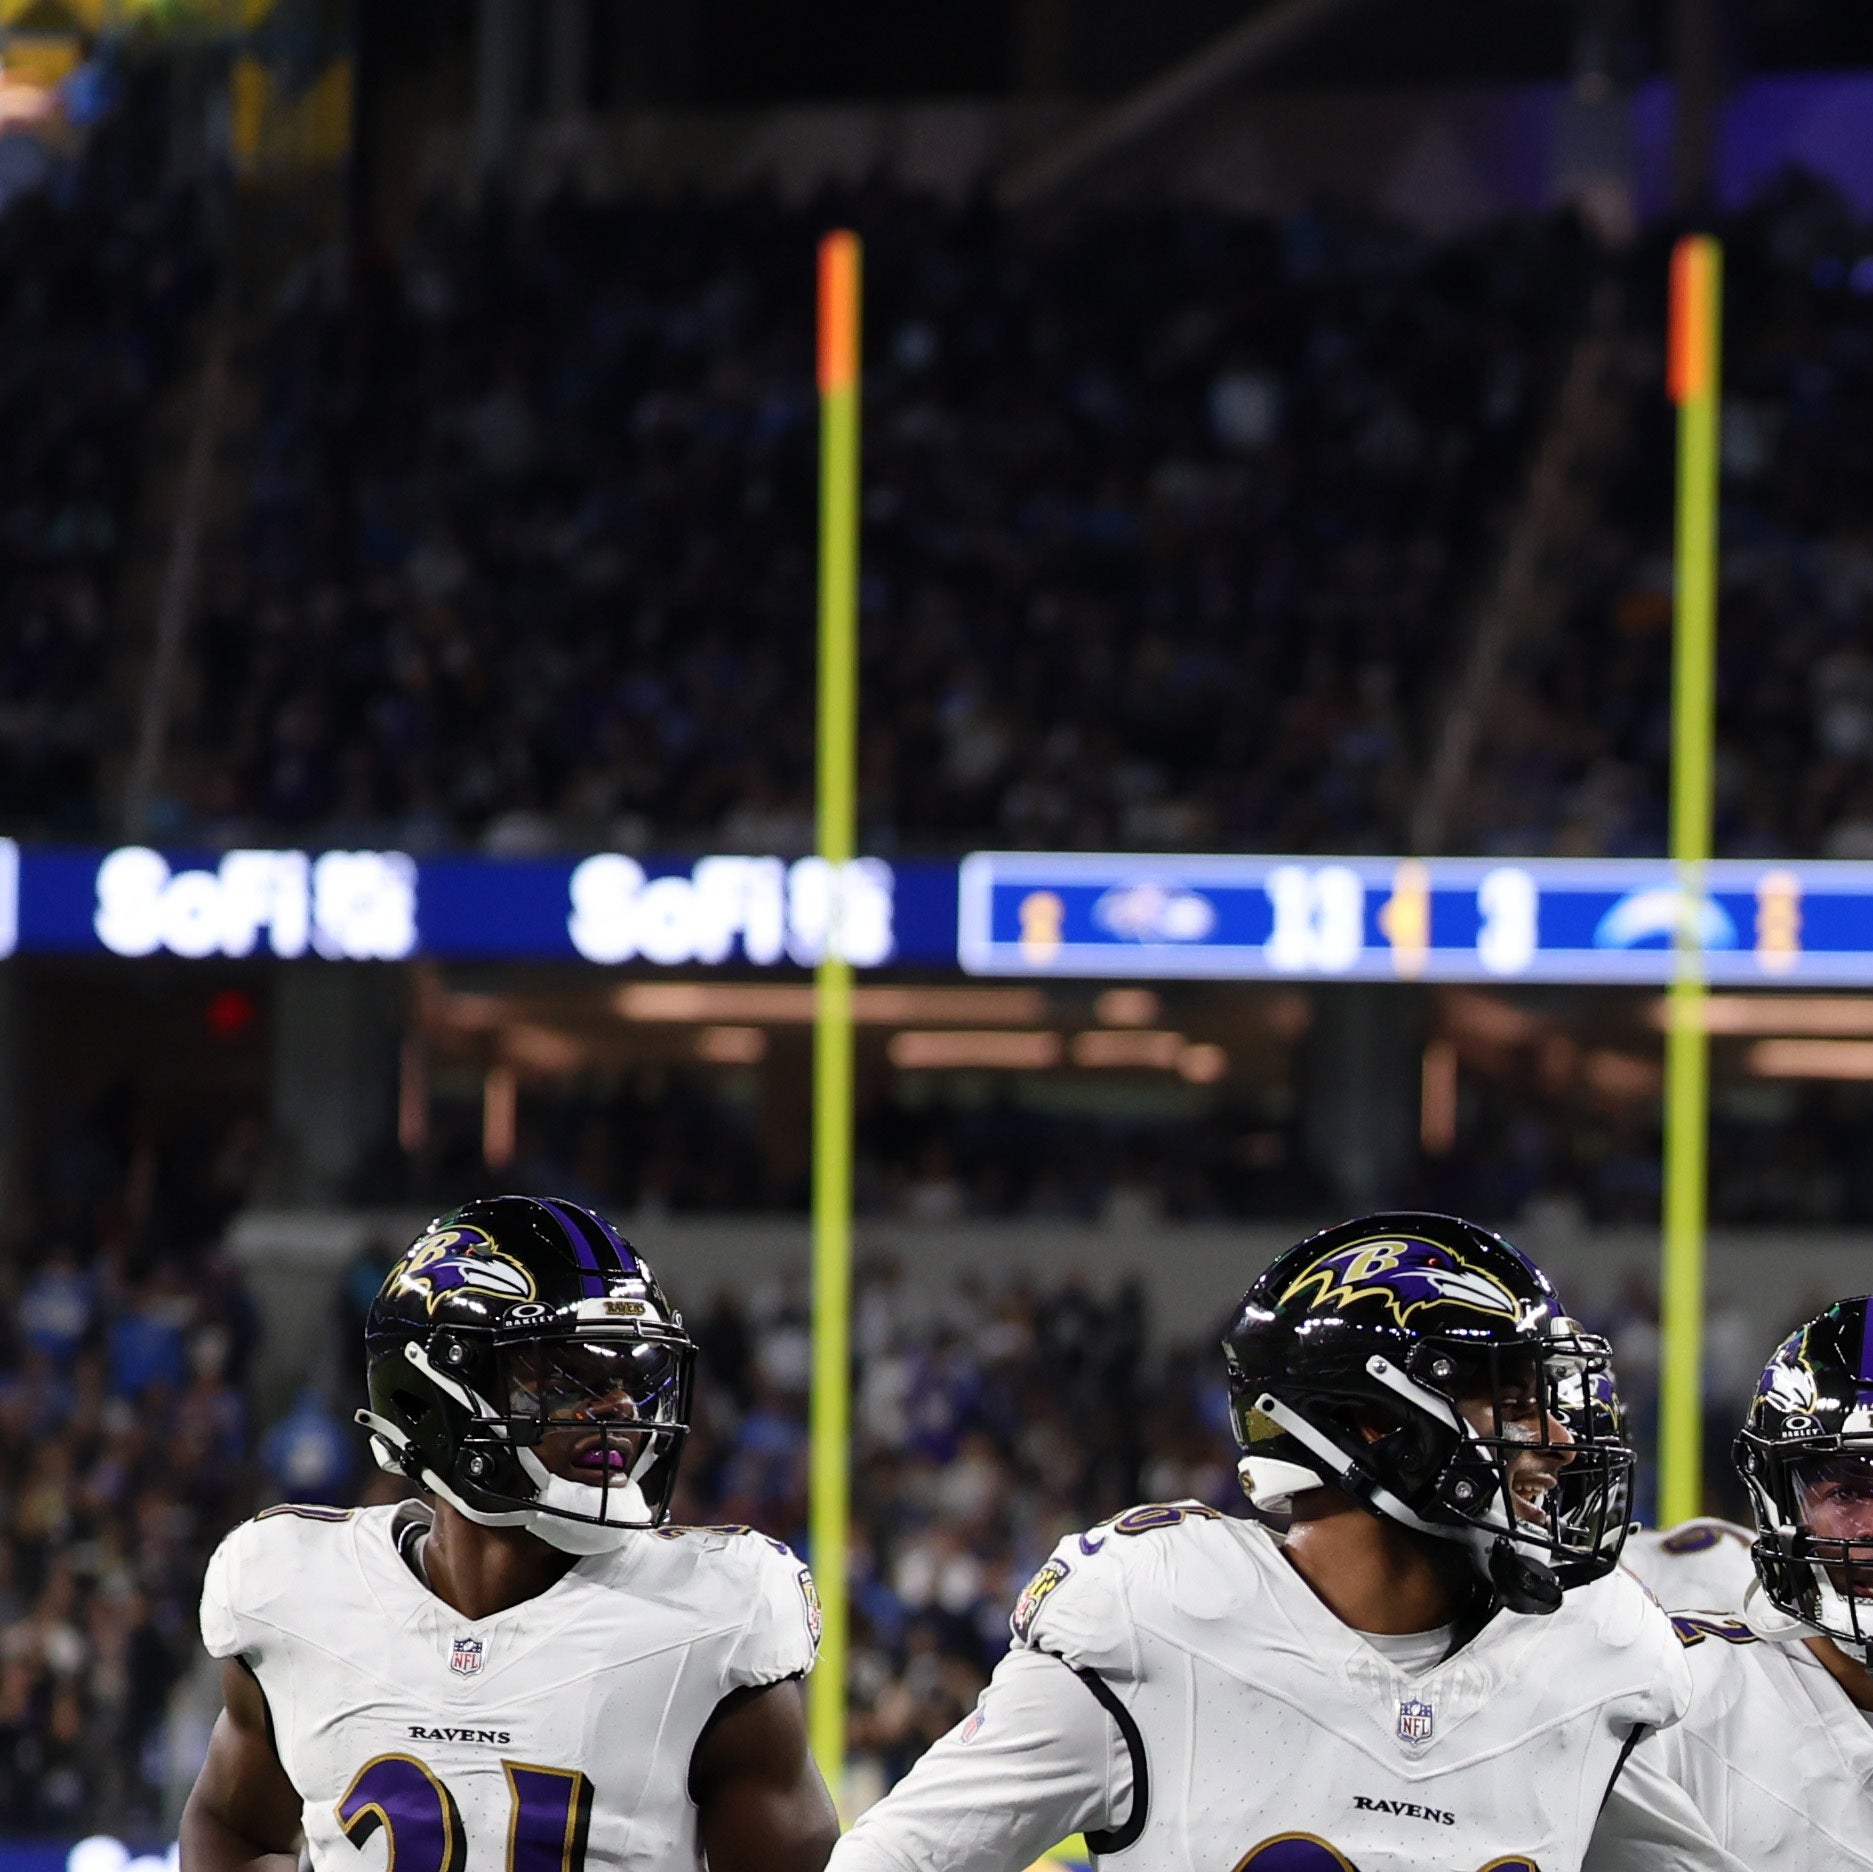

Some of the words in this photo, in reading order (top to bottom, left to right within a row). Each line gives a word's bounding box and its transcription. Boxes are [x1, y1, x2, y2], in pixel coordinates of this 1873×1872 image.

[505, 1314, 553, 1327] OAKLEY
[409, 1726, 511, 1744] RAVENS
[1353, 1795, 1456, 1826] RAVENS
